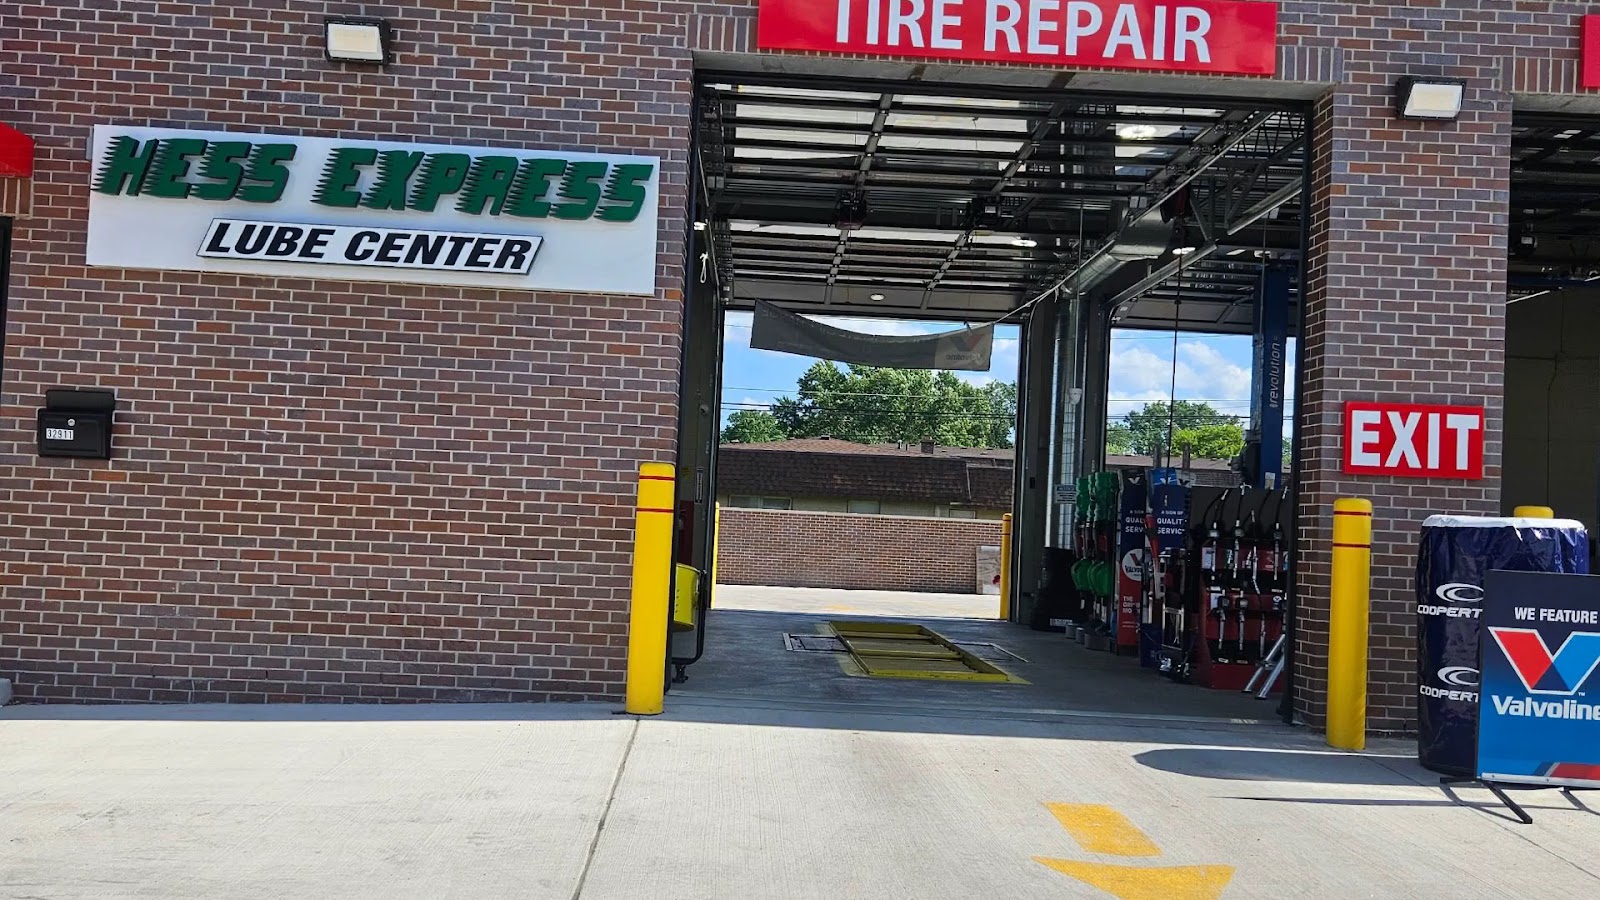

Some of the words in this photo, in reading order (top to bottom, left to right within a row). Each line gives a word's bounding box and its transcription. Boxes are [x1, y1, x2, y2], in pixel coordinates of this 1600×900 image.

[984, 0, 1211, 63] REPAIR
[91, 135, 297, 203] HESS
[310, 147, 653, 222] EXPRESS
[205, 222, 336, 259] LUBE
[344, 231, 533, 271] CENTER
[1269, 342, 1280, 405] revolution
[48, 430, 72, 438] 32911
[1350, 409, 1480, 471] EXIT
[1514, 607, 1535, 621] WE
[1540, 609, 1599, 624] FEATURE
